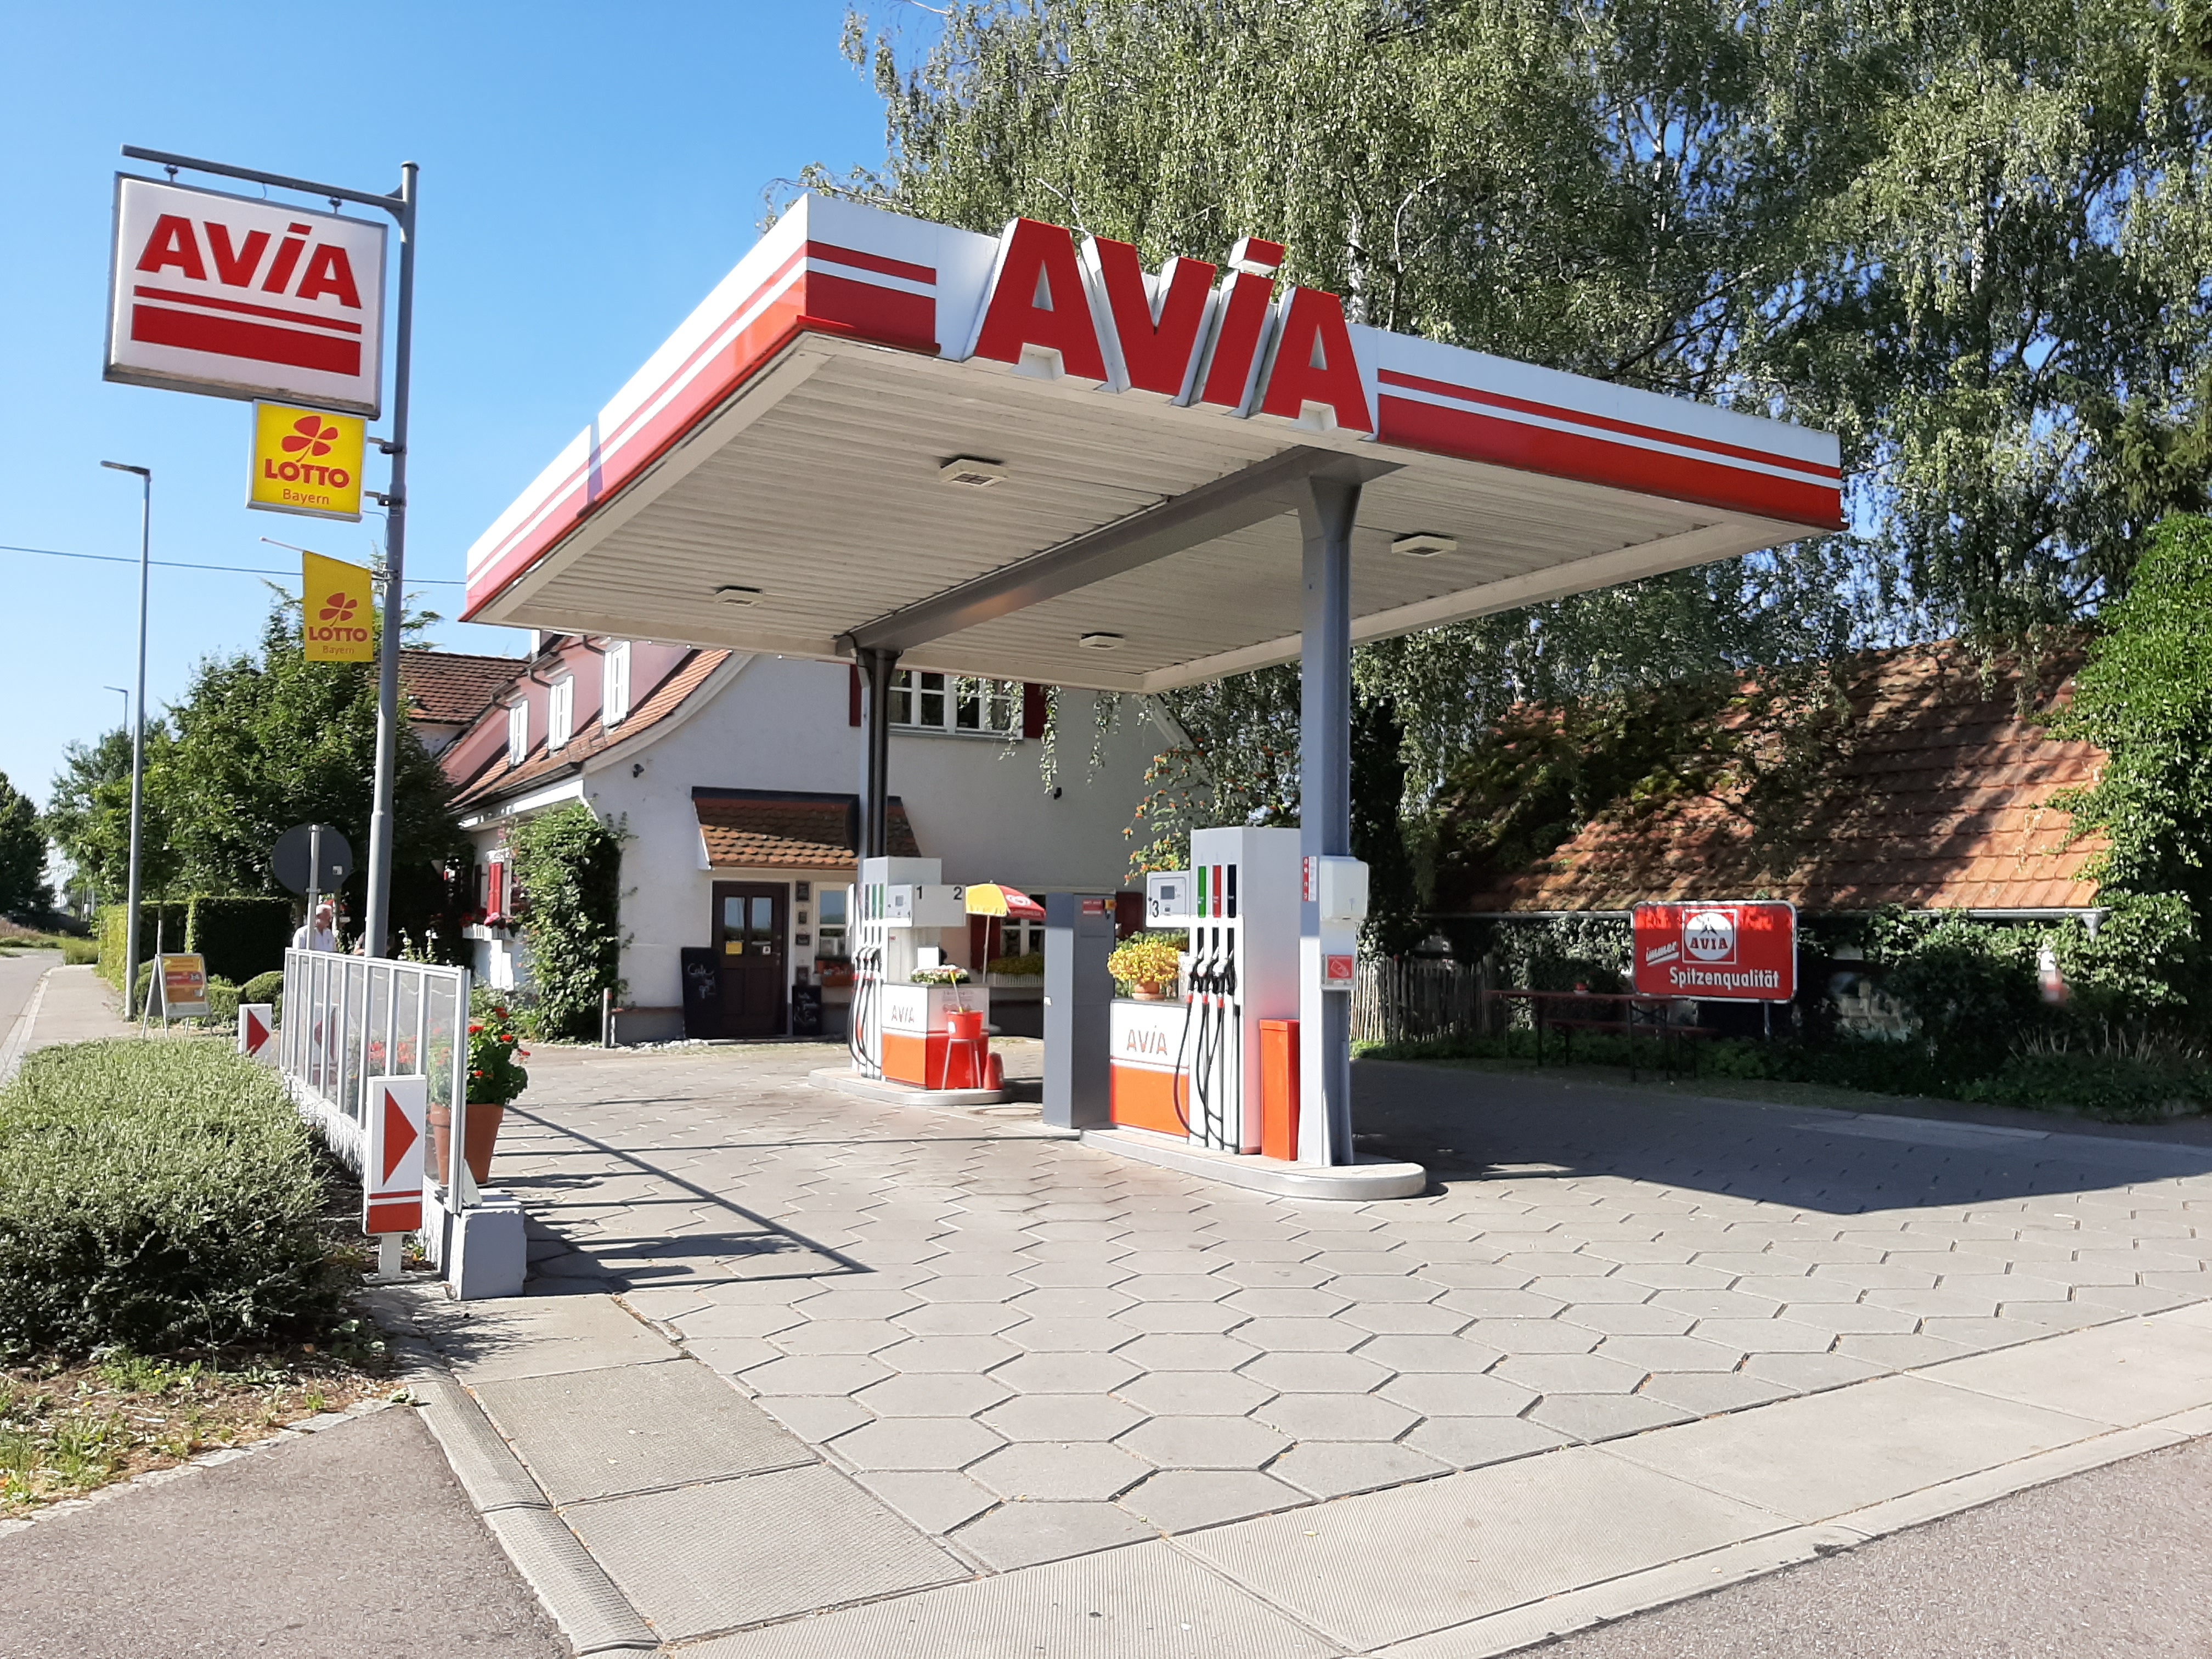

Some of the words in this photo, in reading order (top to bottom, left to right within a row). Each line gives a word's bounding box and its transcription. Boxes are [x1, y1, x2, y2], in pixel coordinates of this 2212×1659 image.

[265, 459, 350, 488] LOTTO
[283, 489, 330, 505] Bayern
[308, 627, 368, 642] LOTTO
[323, 646, 354, 655] Bayern
[916, 885, 923, 900] 1
[953, 886, 962, 900] 2
[1152, 900, 1159, 918] 3
[1690, 937, 1728, 950] AVIA
[1669, 966, 1779, 991] Spitzenqualität
